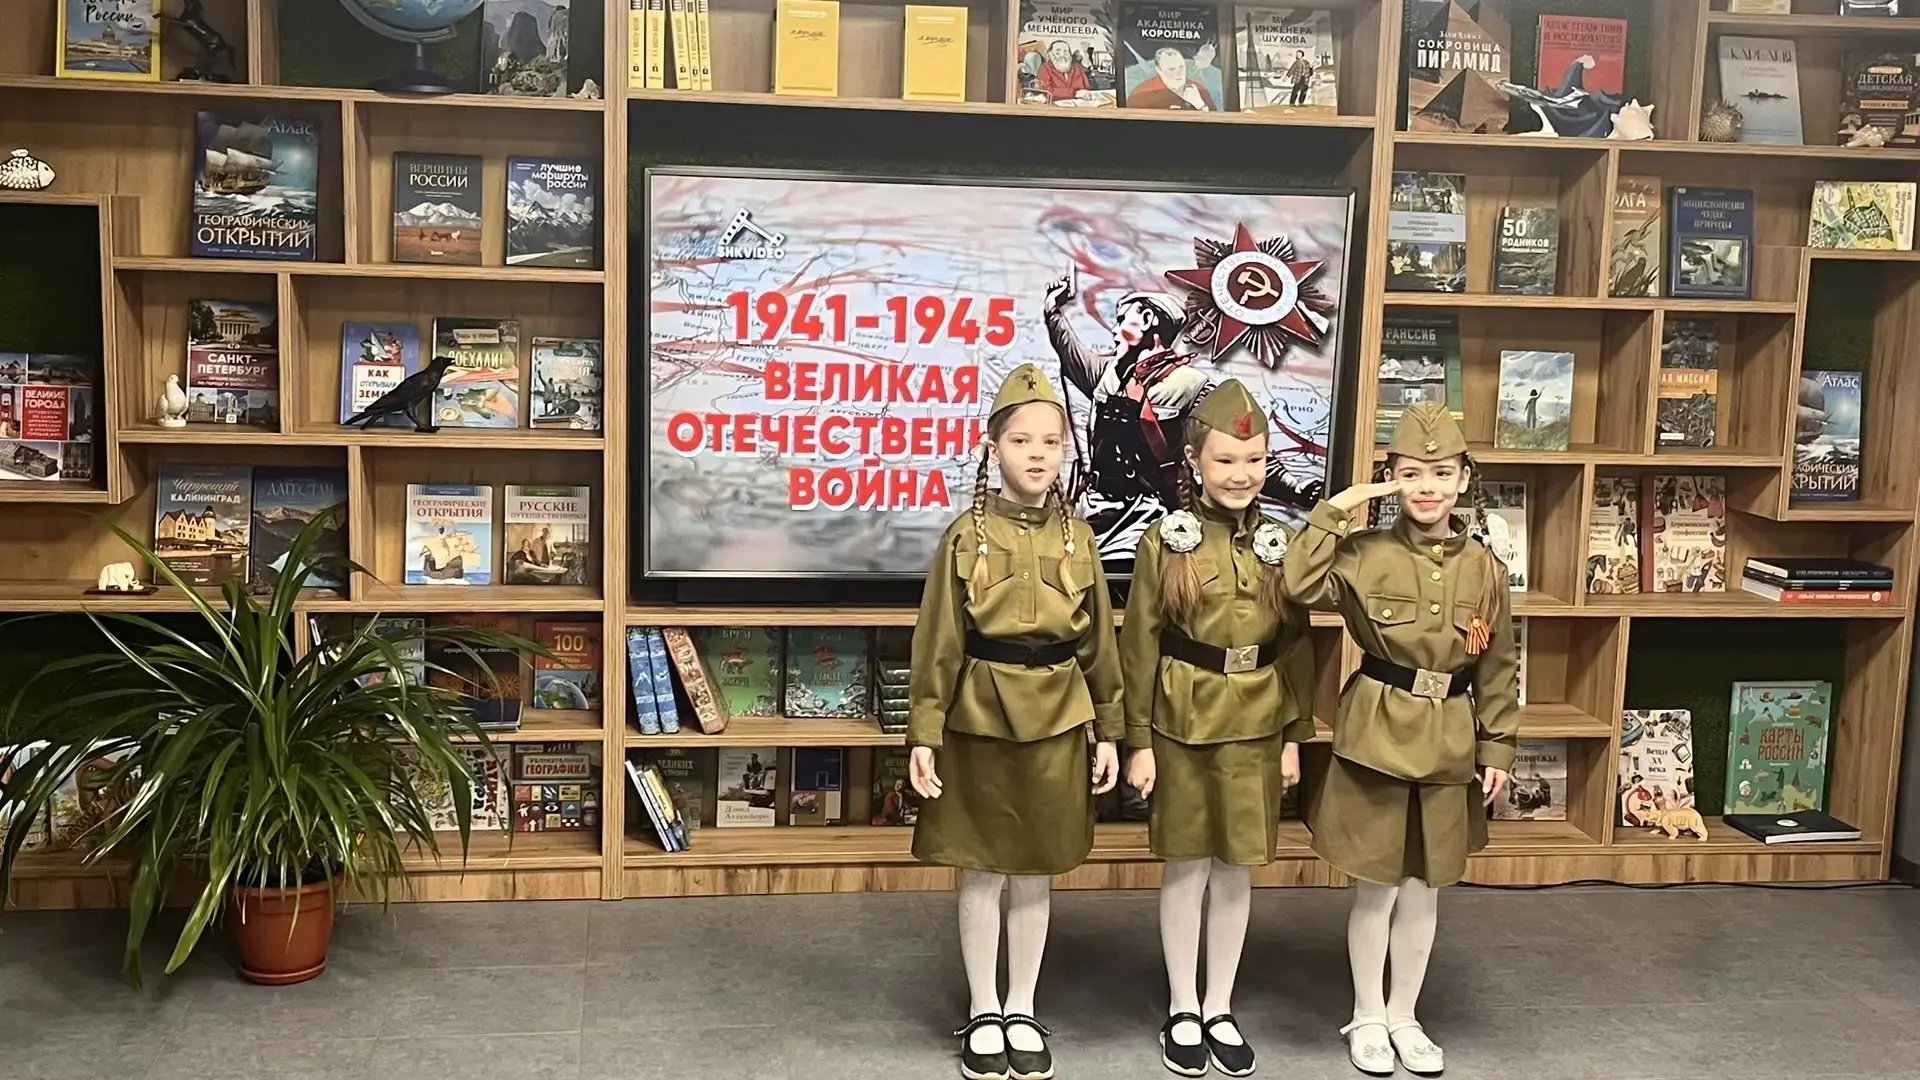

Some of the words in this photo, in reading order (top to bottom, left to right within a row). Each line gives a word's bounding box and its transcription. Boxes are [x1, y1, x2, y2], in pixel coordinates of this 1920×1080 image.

[1051, 6, 1073, 15] МИР
[1158, 11, 1181, 19] МИР
[1027, 24, 1099, 35] МЕНДЕЛЕЕВА
[1136, 19, 1204, 30] АКАДЕМИКА
[1255, 25, 1313, 35] ИНЖЕНЕРА
[1262, 34, 1307, 44] ШУХОВА
[1418, 39, 1501, 53] СОКРОВИЩА
[1417, 49, 1501, 73] ПИРАМИД
[1857, 74, 1913, 85] ДЕТСКАЯ
[267, 119, 314, 137] Атлас
[410, 163, 468, 175] ВЕРШИНЫ
[540, 163, 582, 175] лучшие
[410, 174, 468, 188] РОССИИ
[531, 171, 589, 184] маршруты
[546, 180, 586, 190] россии
[198, 214, 311, 231] ГЕОГРАФИЧЕСКИХ
[1502, 219, 1527, 238] 50
[1502, 237, 1549, 248] РОДНИКОВ
[717, 246, 785, 260] SHKVIDEO
[727, 291, 1017, 347] 1941-1945
[1386, 328, 1436, 341] РАНССИБ
[208, 353, 257, 364] САНКТ-
[197, 364, 268, 376] ПЕТЕРБУРГ
[368, 369, 389, 378] КАК
[763, 362, 980, 404] ВЕЛИКАЯ
[1676, 373, 1710, 385] МИССИЯ
[1823, 373, 1859, 389] Атлас
[25, 389, 66, 400] ВЕЛИКИЕ
[25, 400, 66, 409] ГОРОДА
[1793, 463, 1857, 474] РАФИЧЕСКИХ
[788, 458, 951, 510] ВОЙНА
[1792, 474, 1856, 491] КРЫТИЙ
[171, 493, 241, 504] КАЛИНИНГРАД
[413, 499, 487, 508] ГЕОГРАФИЧЕСКИЕ
[519, 501, 578, 512] РУССКИЕ
[416, 507, 483, 518] ОТКРЫТИЯ
[554, 634, 584, 652] 100
[525, 764, 588, 775] ГЕОГРАФИКА
